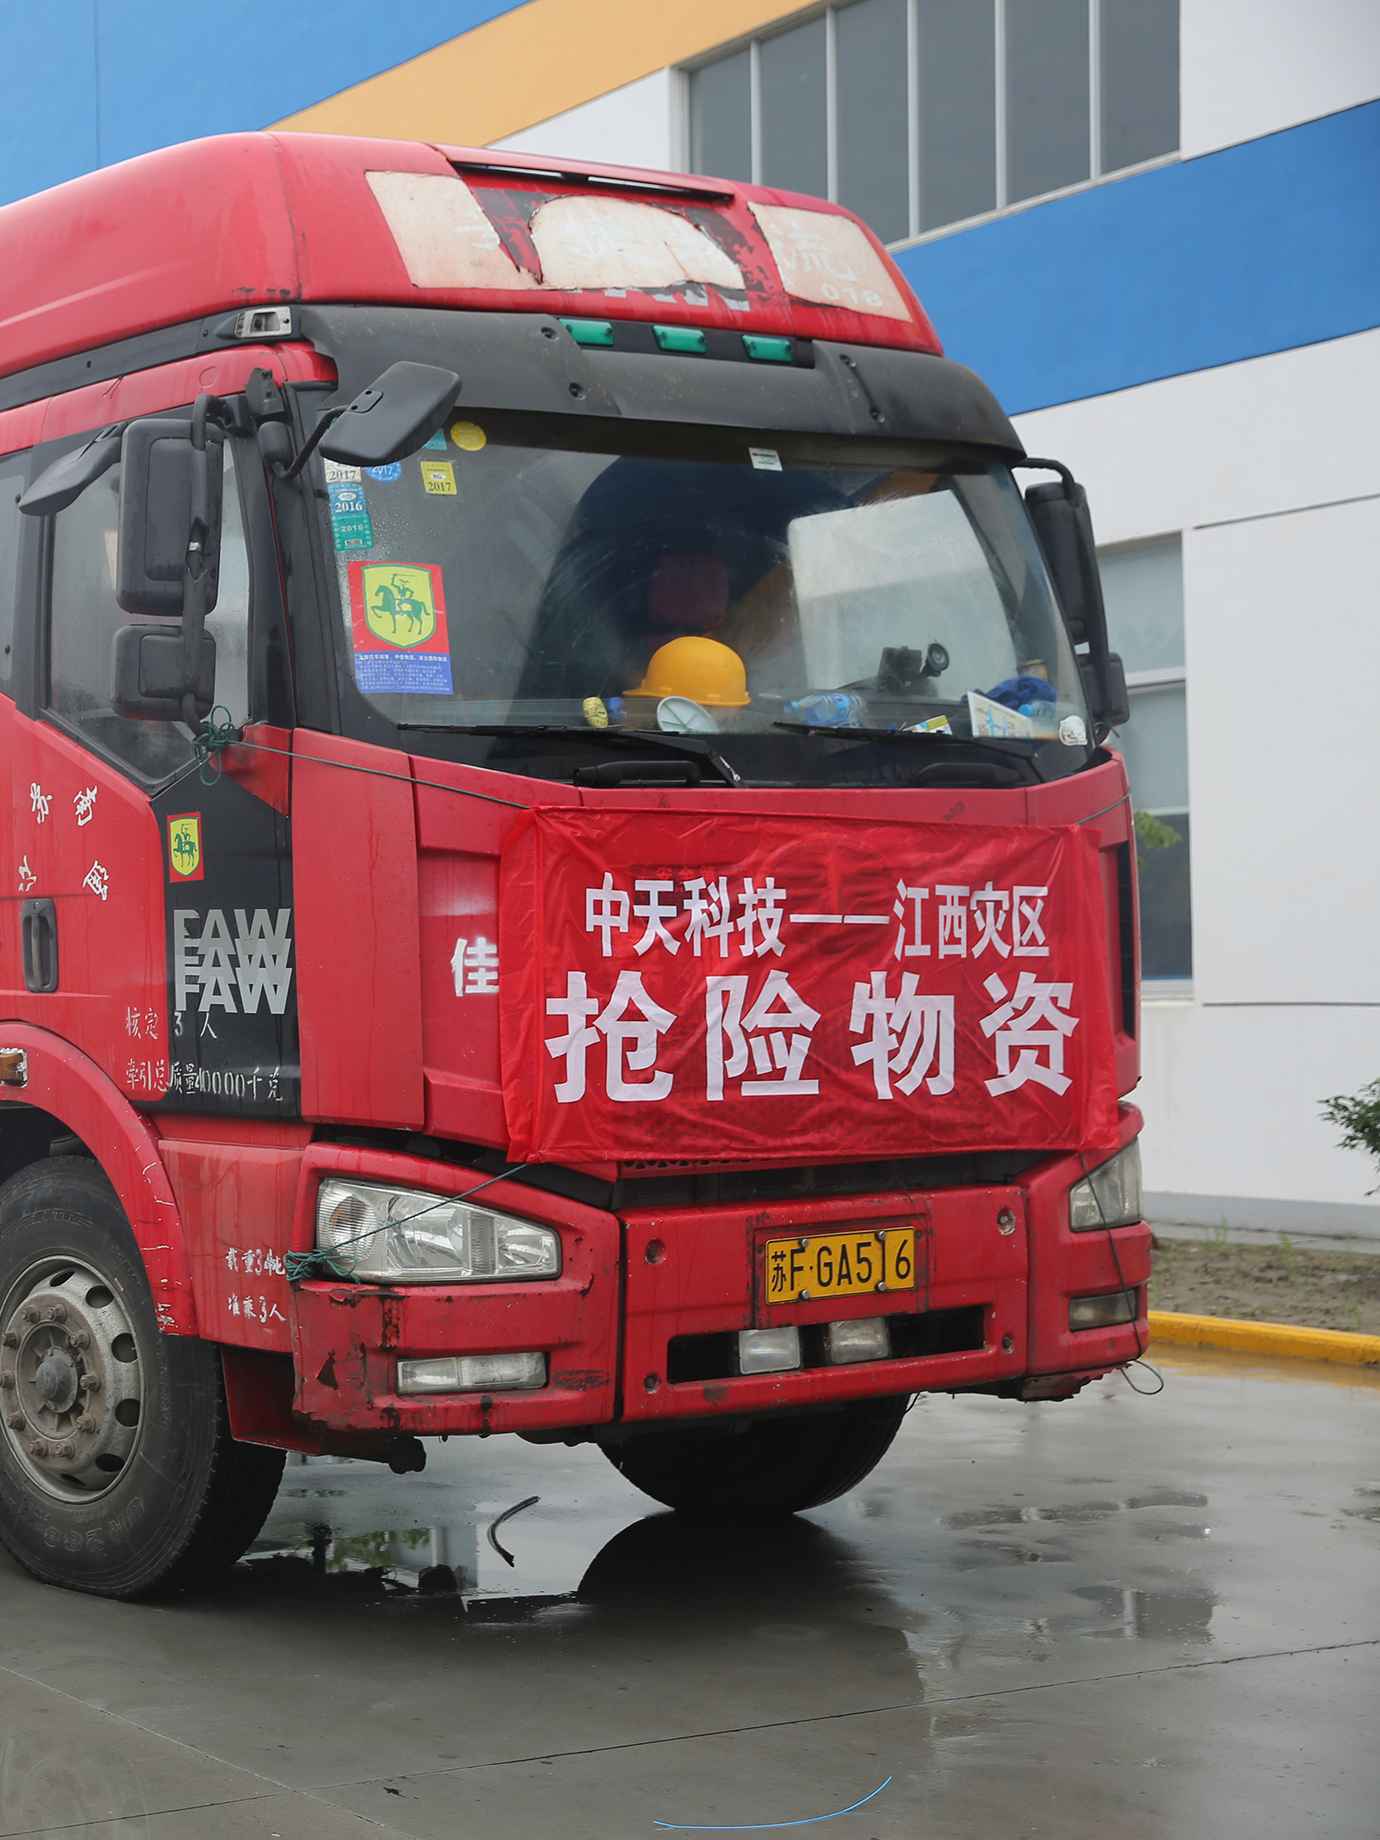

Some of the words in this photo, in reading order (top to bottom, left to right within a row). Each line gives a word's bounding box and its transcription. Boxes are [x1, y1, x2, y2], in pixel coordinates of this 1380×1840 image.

[821, 283, 883, 307] 018
[329, 470, 356, 480] 2017
[427, 481, 451, 492] 2017
[334, 500, 363, 513] 2016
[450, 936, 500, 997] 佳
[544, 968, 1081, 1103] 抢险物资
